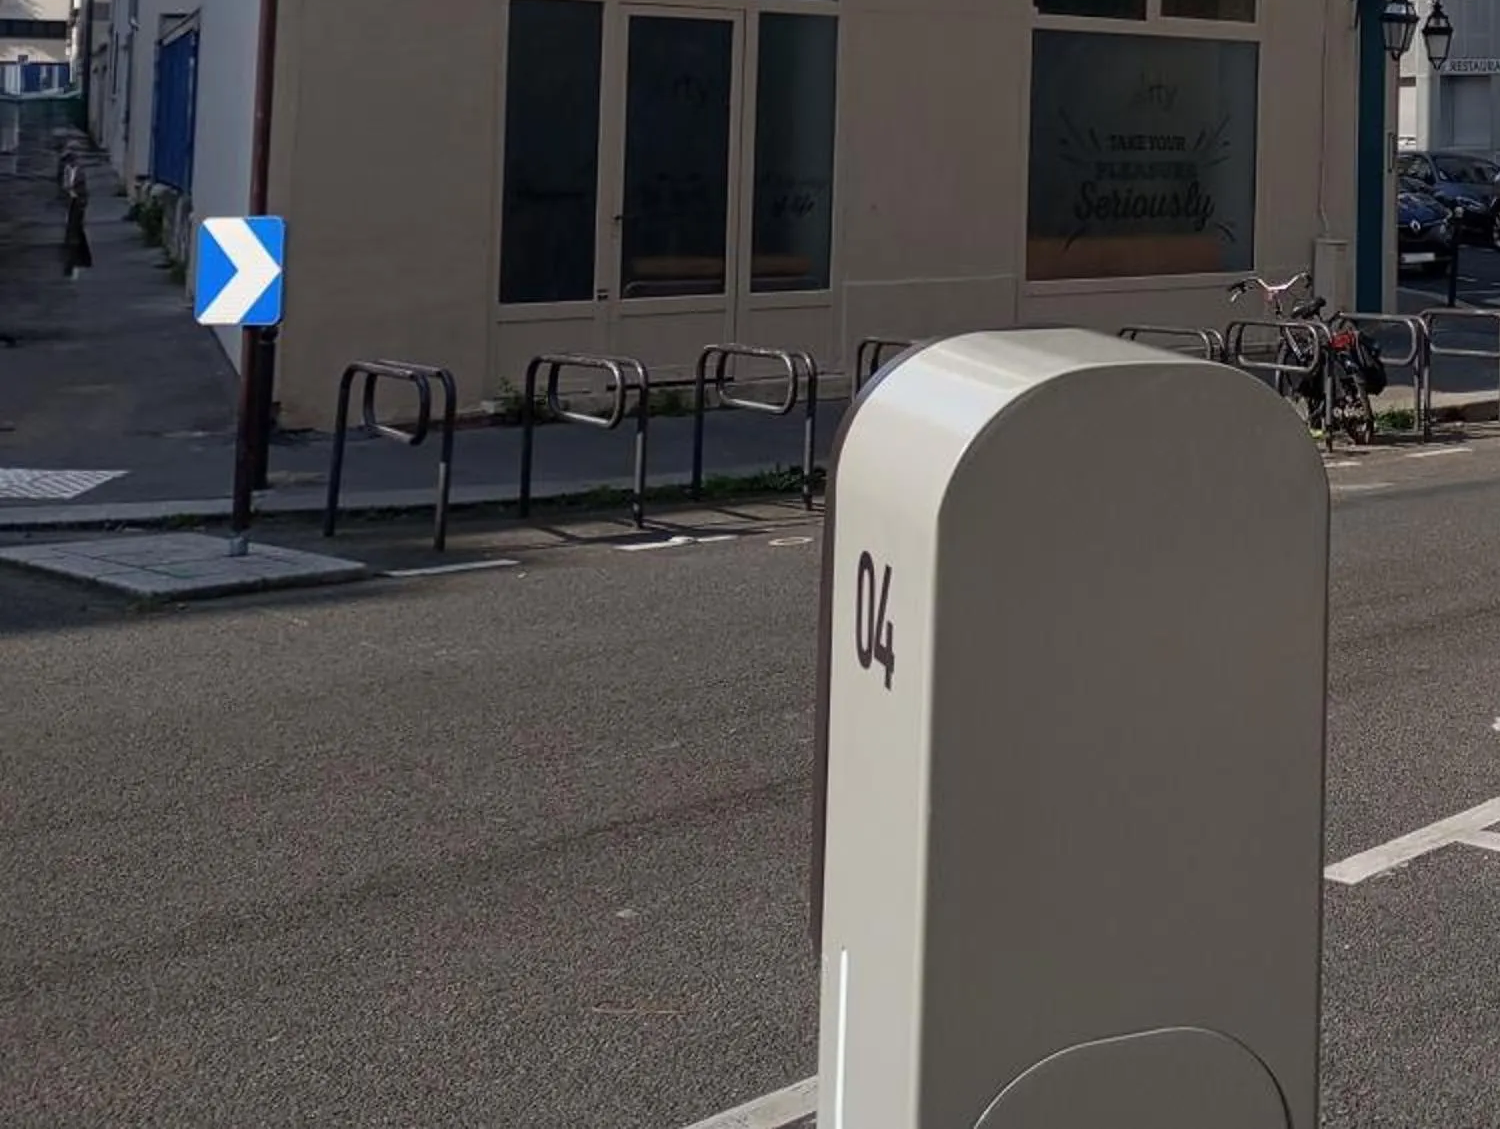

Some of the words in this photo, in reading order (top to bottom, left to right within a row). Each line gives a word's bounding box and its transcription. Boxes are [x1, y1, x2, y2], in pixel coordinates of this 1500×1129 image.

[1149, 134, 1186, 151] YOUR
[1074, 181, 1215, 231] Seriously
[857, 551, 894, 691] 04
